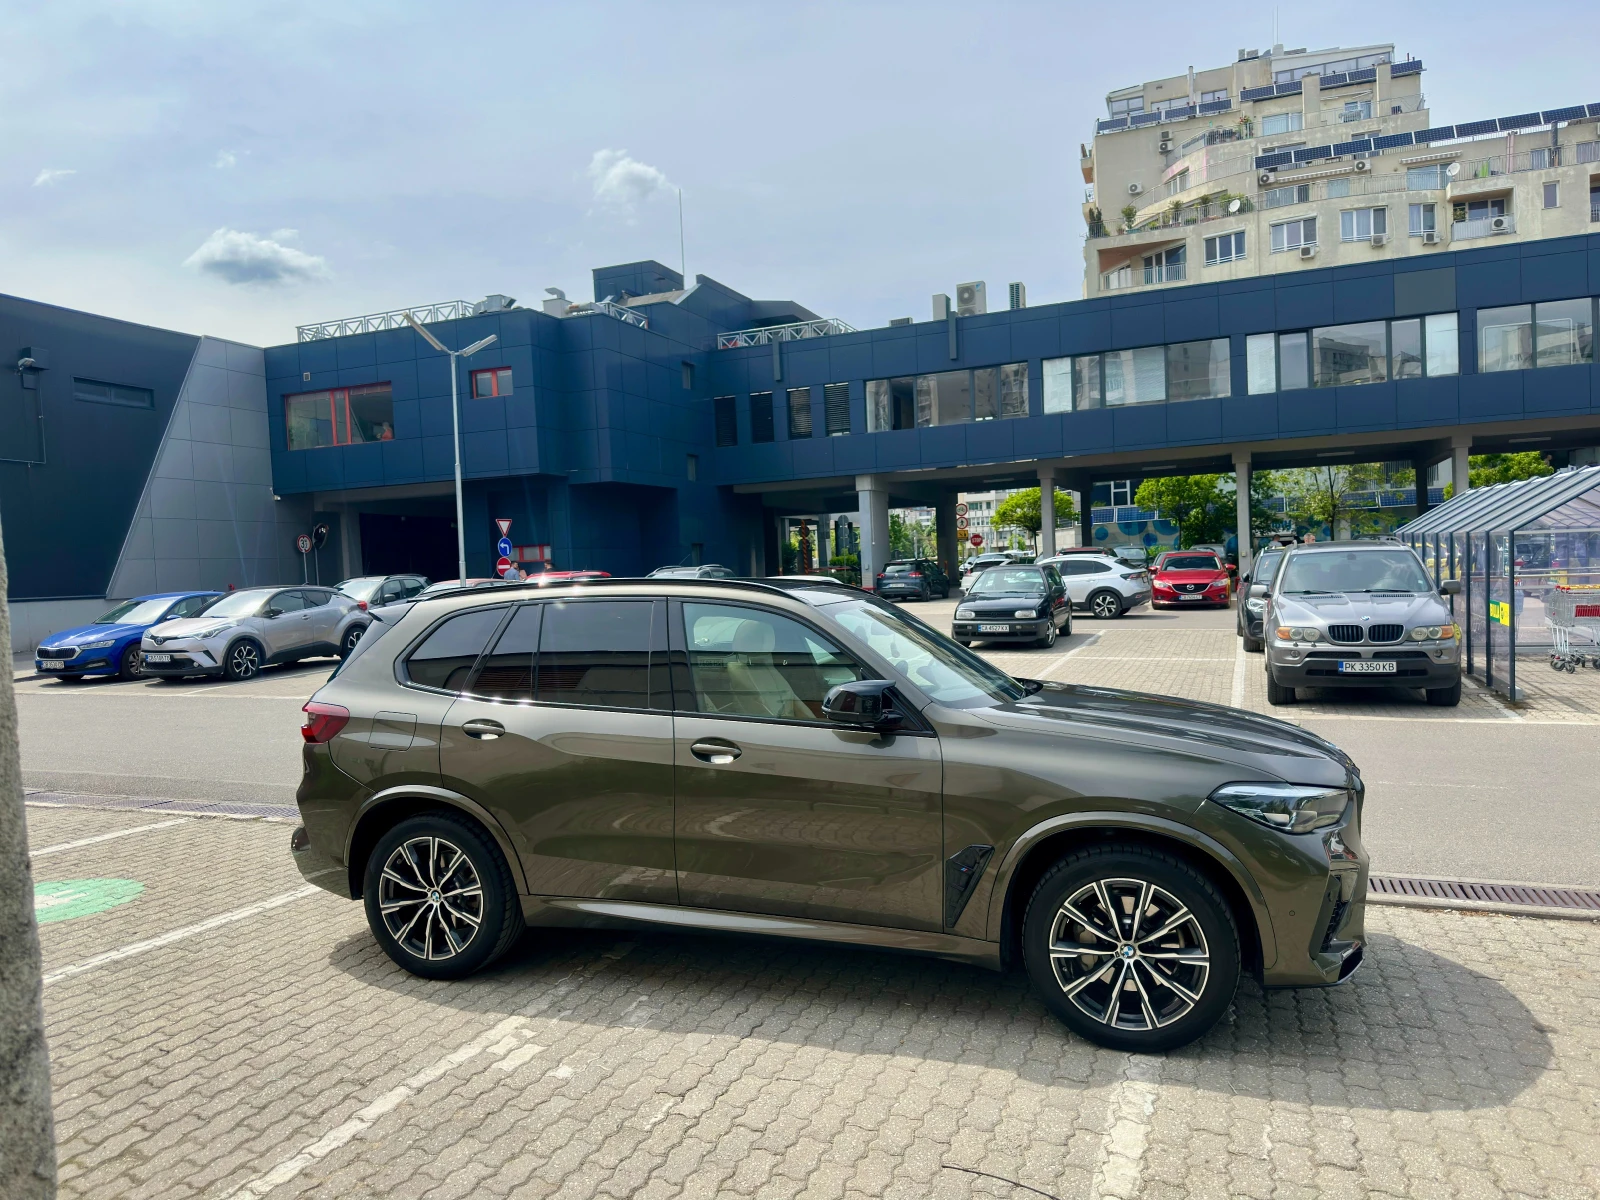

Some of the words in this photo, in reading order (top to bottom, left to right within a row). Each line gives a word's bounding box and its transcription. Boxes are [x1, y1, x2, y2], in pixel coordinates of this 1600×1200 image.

[1344, 662, 1357, 671] PK
[1358, 662, 1381, 671] 3350
[1382, 662, 1395, 671] KB
